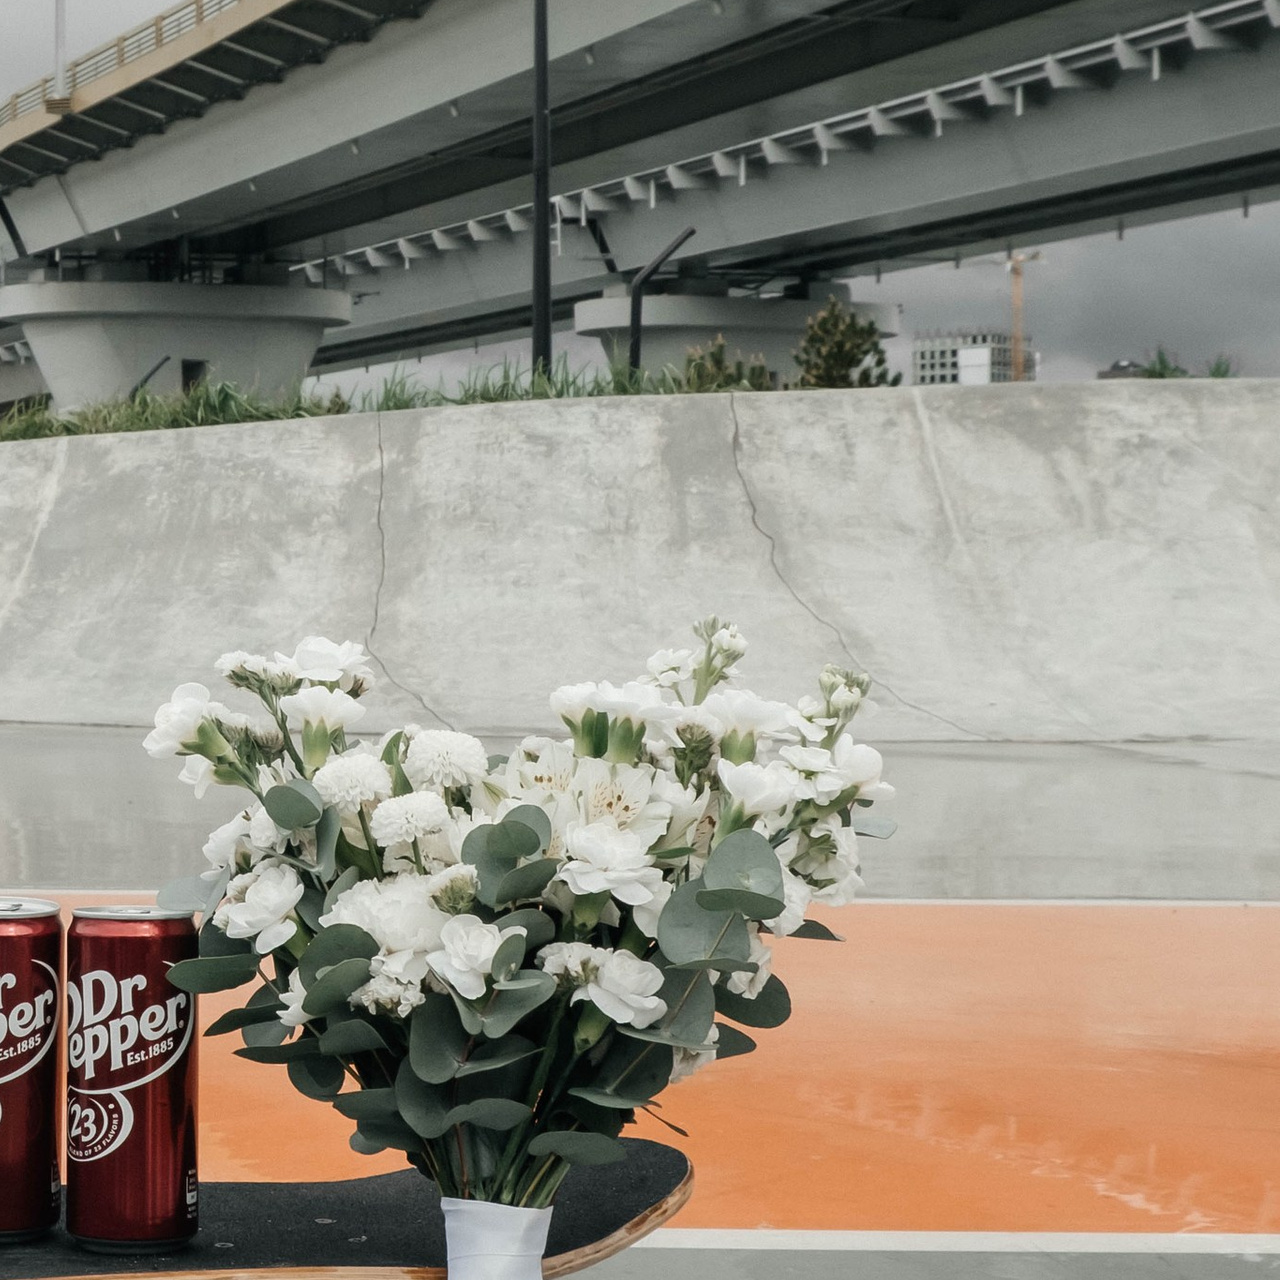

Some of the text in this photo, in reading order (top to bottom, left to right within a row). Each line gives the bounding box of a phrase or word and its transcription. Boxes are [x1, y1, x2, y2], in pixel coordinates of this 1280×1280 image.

[80, 969, 147, 1028] Dr
[70, 1103, 97, 1142] 23
[94, 1144, 102, 1153] 23
[102, 1113, 119, 1146] FLAVORS
